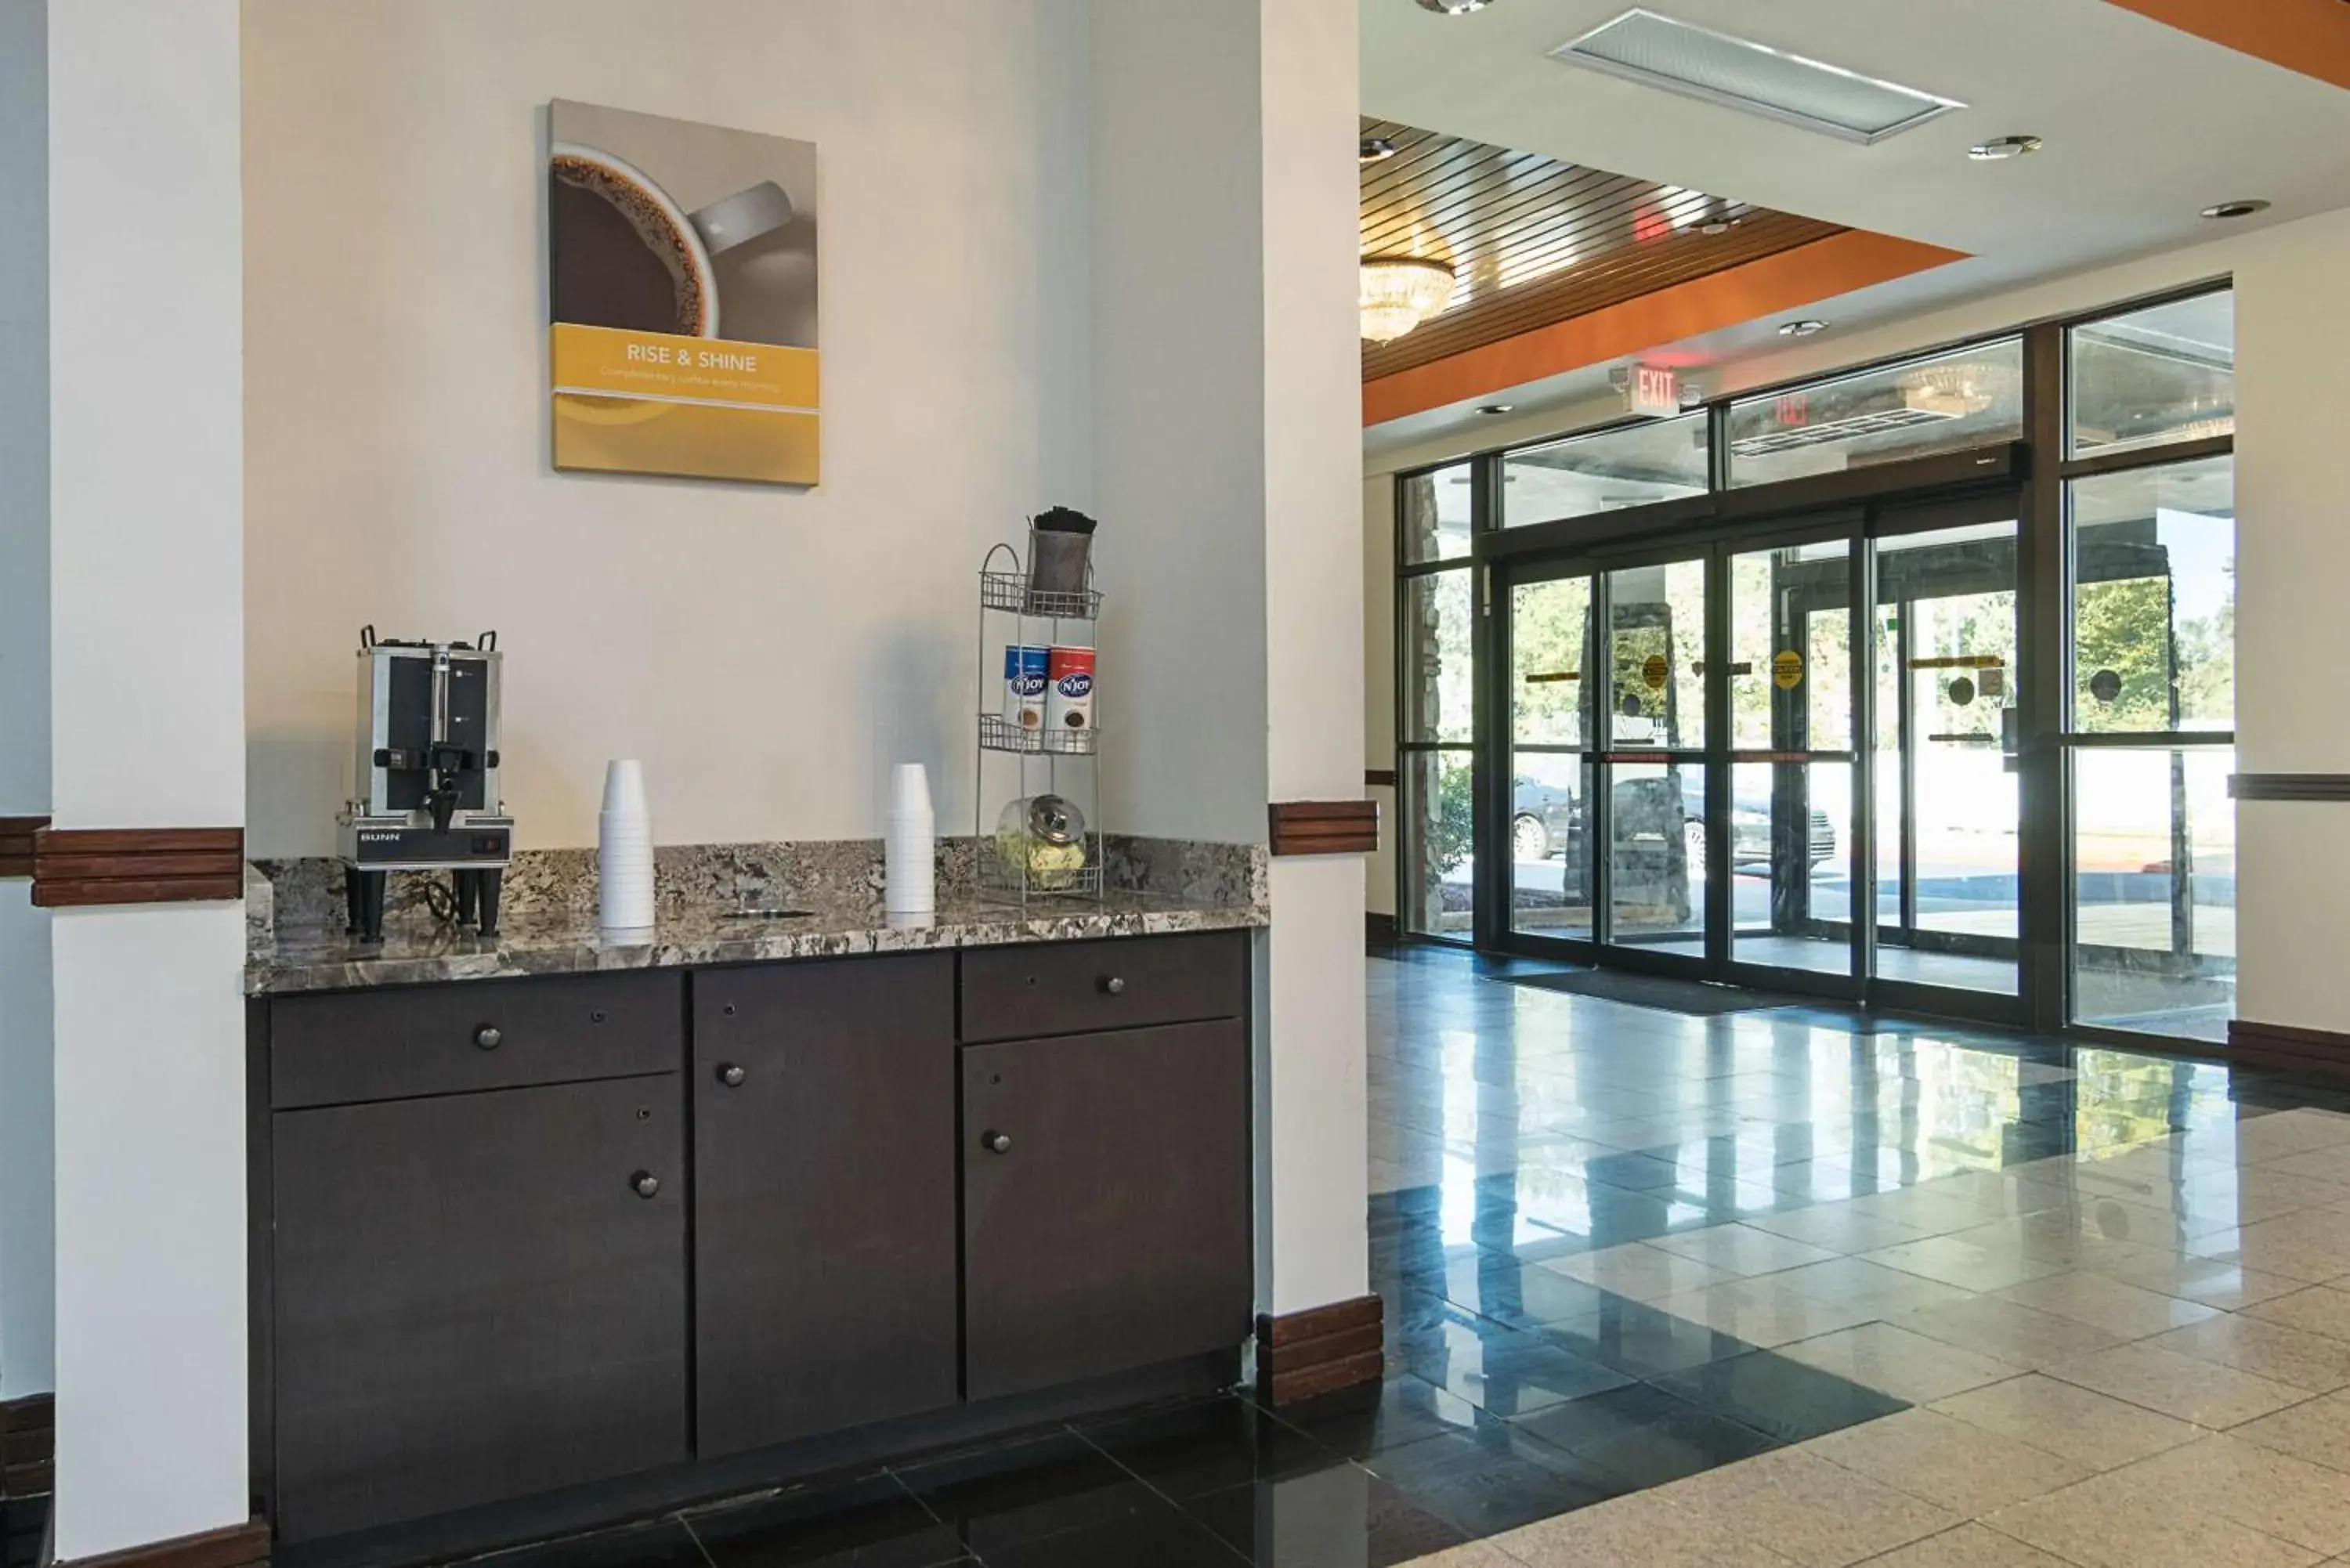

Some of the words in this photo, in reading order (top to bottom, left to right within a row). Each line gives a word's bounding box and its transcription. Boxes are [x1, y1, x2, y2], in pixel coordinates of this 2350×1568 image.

[627, 344, 671, 363] RISE
[677, 349, 692, 367] &
[699, 351, 757, 373] SHINE
[1639, 369, 1674, 408] EXIT
[361, 833, 400, 841] BUNN
